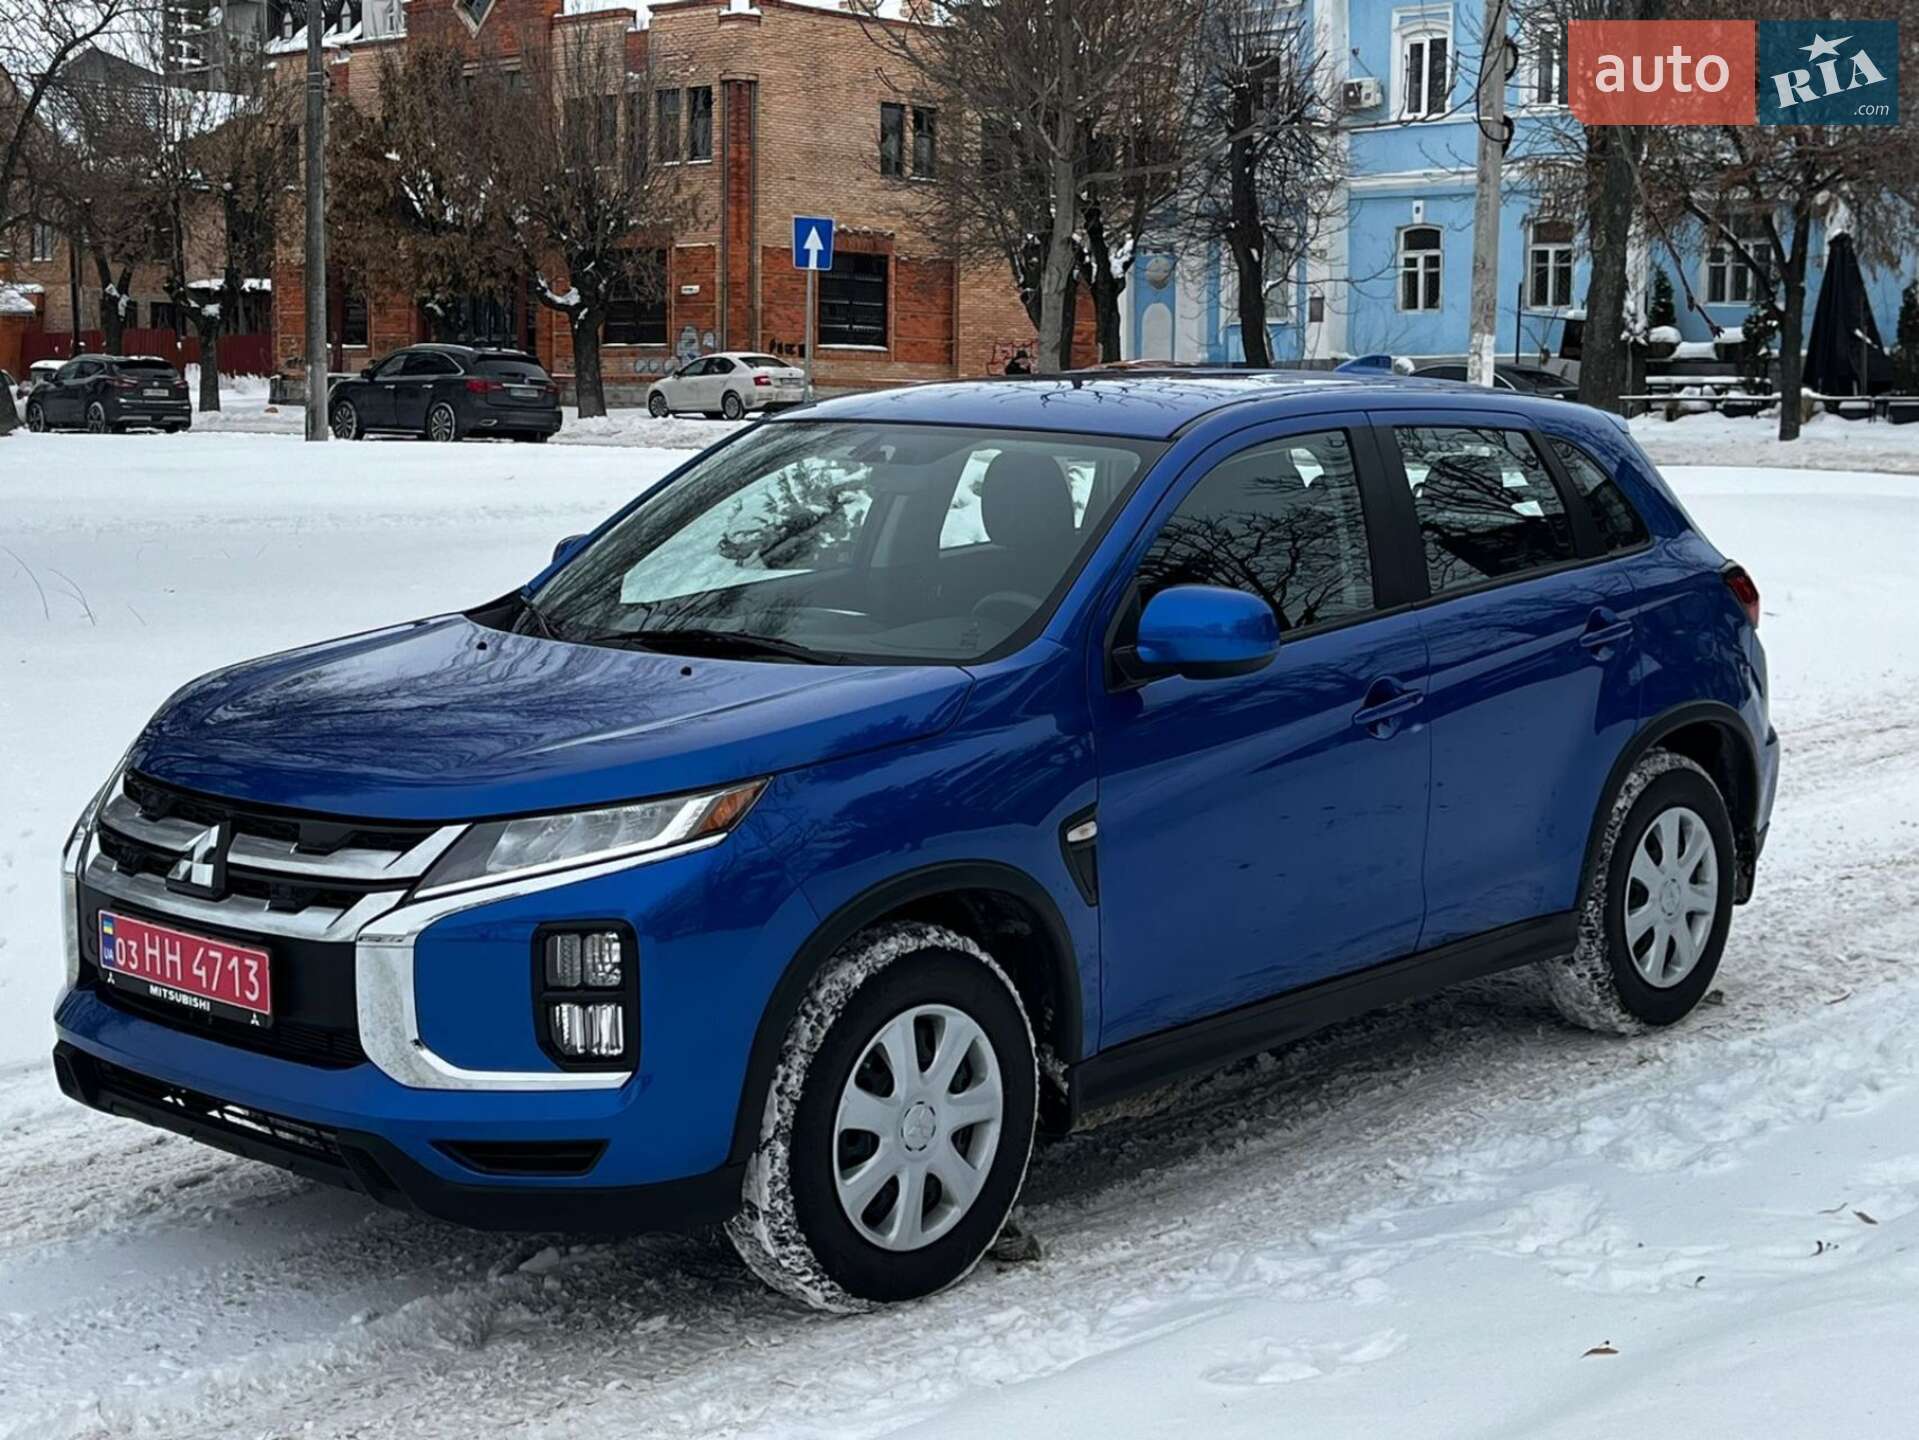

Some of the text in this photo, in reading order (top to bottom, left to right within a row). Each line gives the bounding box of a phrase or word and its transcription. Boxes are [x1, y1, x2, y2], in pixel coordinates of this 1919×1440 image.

[103, 948, 114, 961] UA
[115, 932, 260, 1001] 03 HH 4713
[150, 985, 210, 1012] MITSUBISHI
